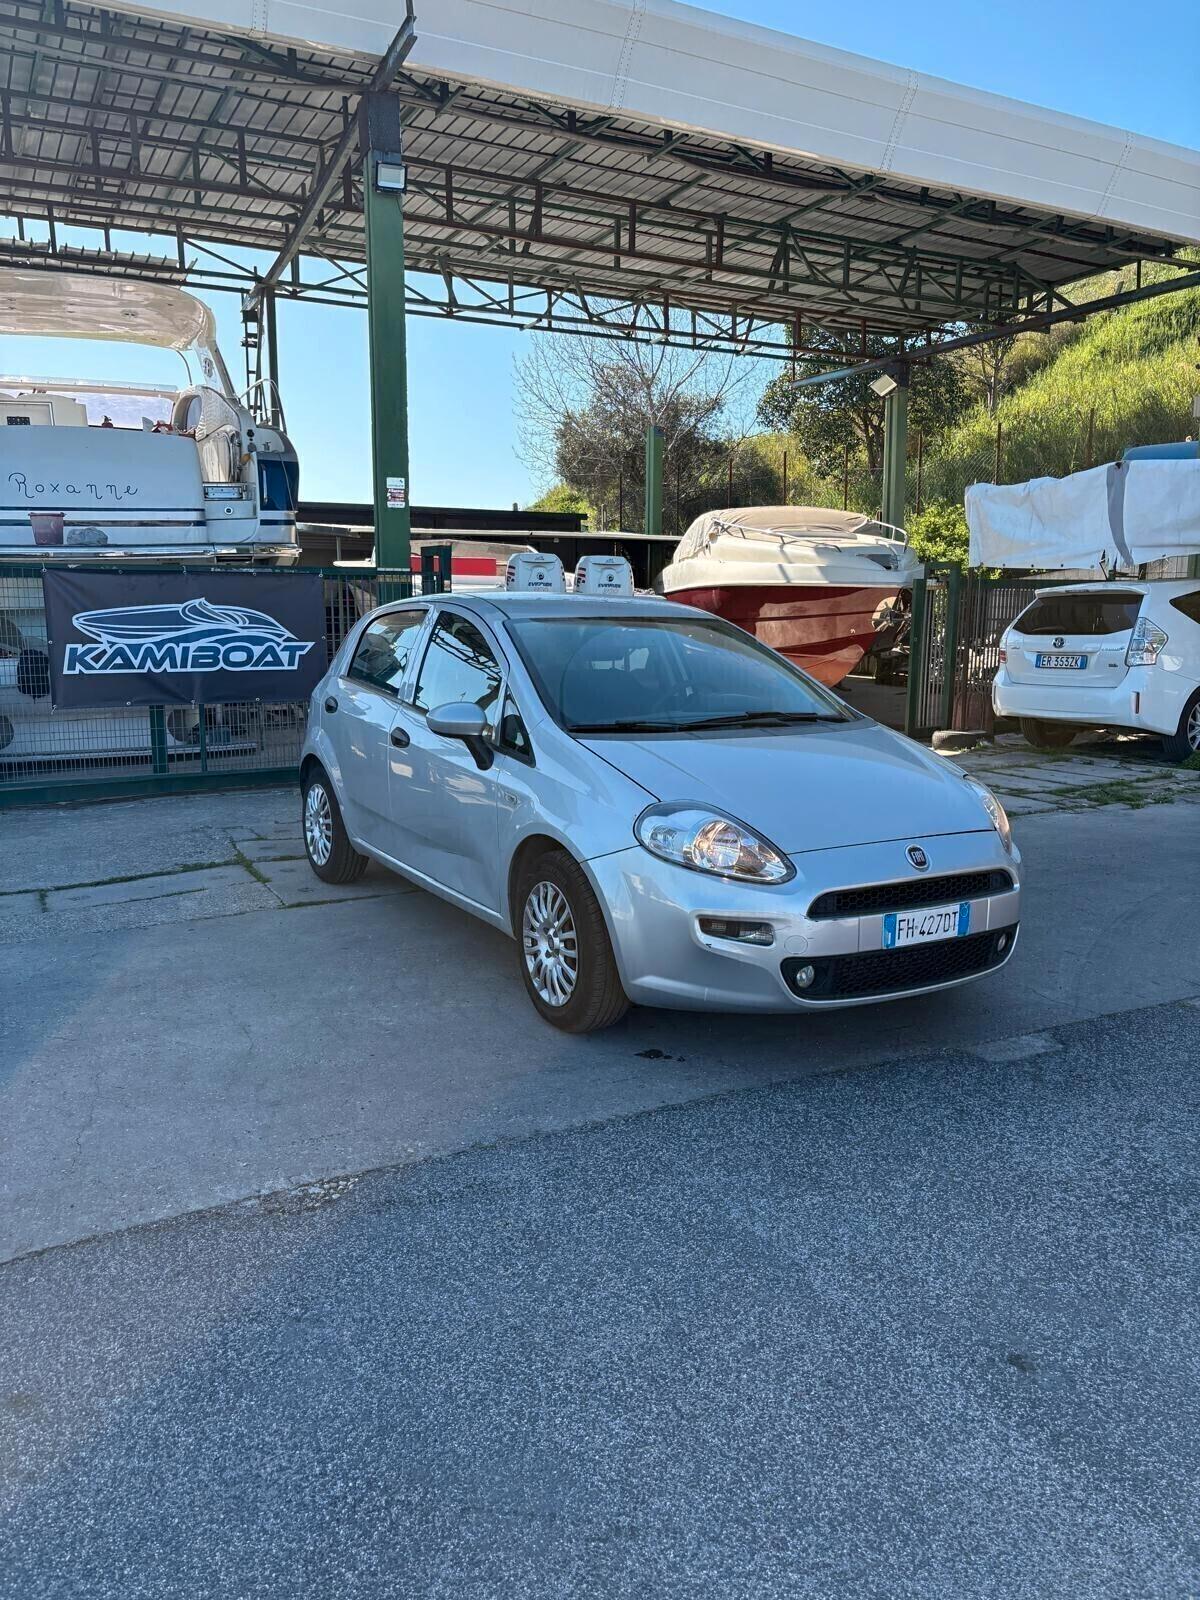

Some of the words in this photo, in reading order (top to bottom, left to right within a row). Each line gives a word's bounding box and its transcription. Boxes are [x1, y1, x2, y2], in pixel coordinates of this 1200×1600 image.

[9, 472, 138, 500] Roxanne
[63, 642, 315, 674] KAMIBOAT
[910, 851, 926, 862] FIAT
